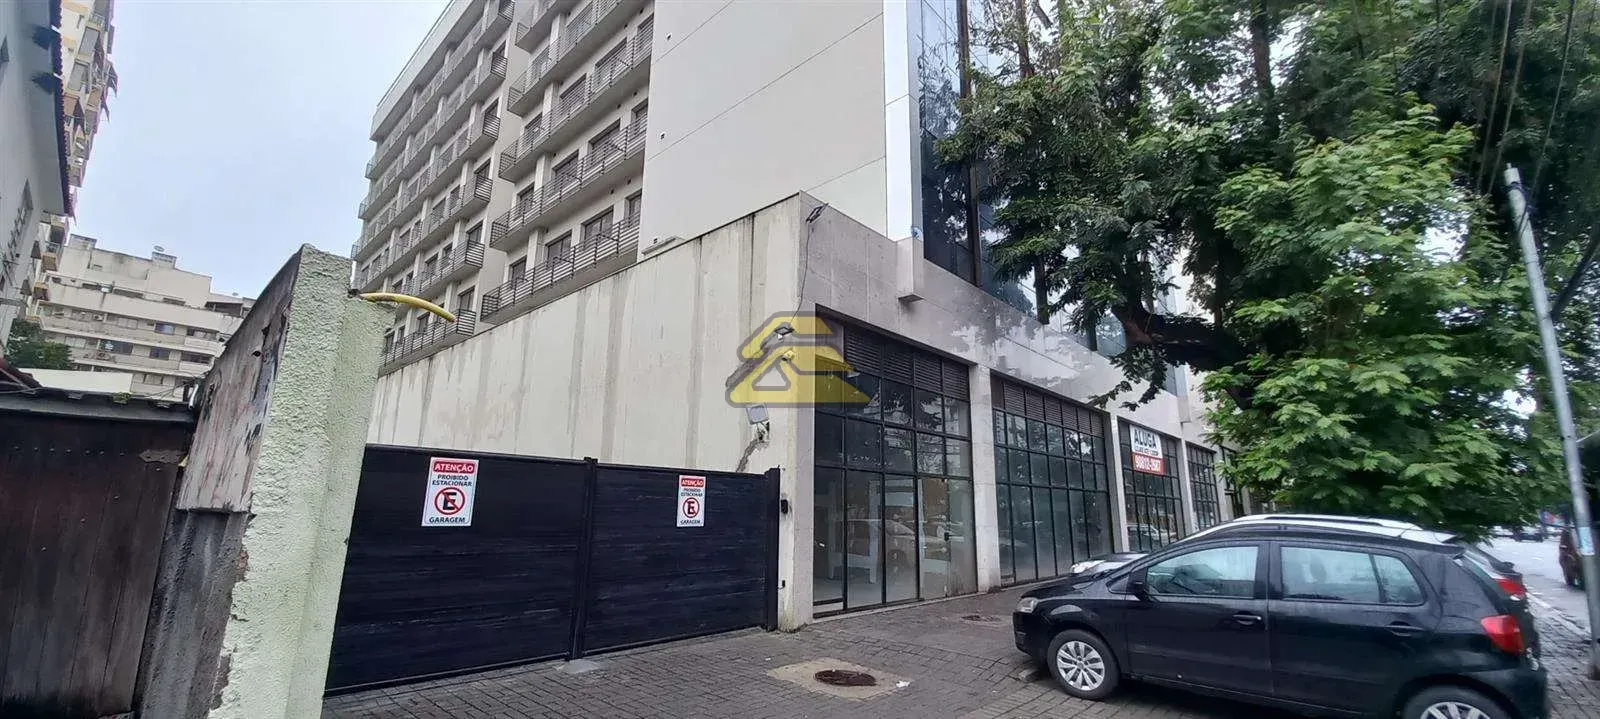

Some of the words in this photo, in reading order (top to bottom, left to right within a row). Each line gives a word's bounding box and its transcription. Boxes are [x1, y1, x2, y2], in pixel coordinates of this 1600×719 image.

[1134, 429, 1157, 449] ALUGA
[434, 463, 474, 473] ATENÇÃO
[681, 479, 704, 487] ATENÇÃO
